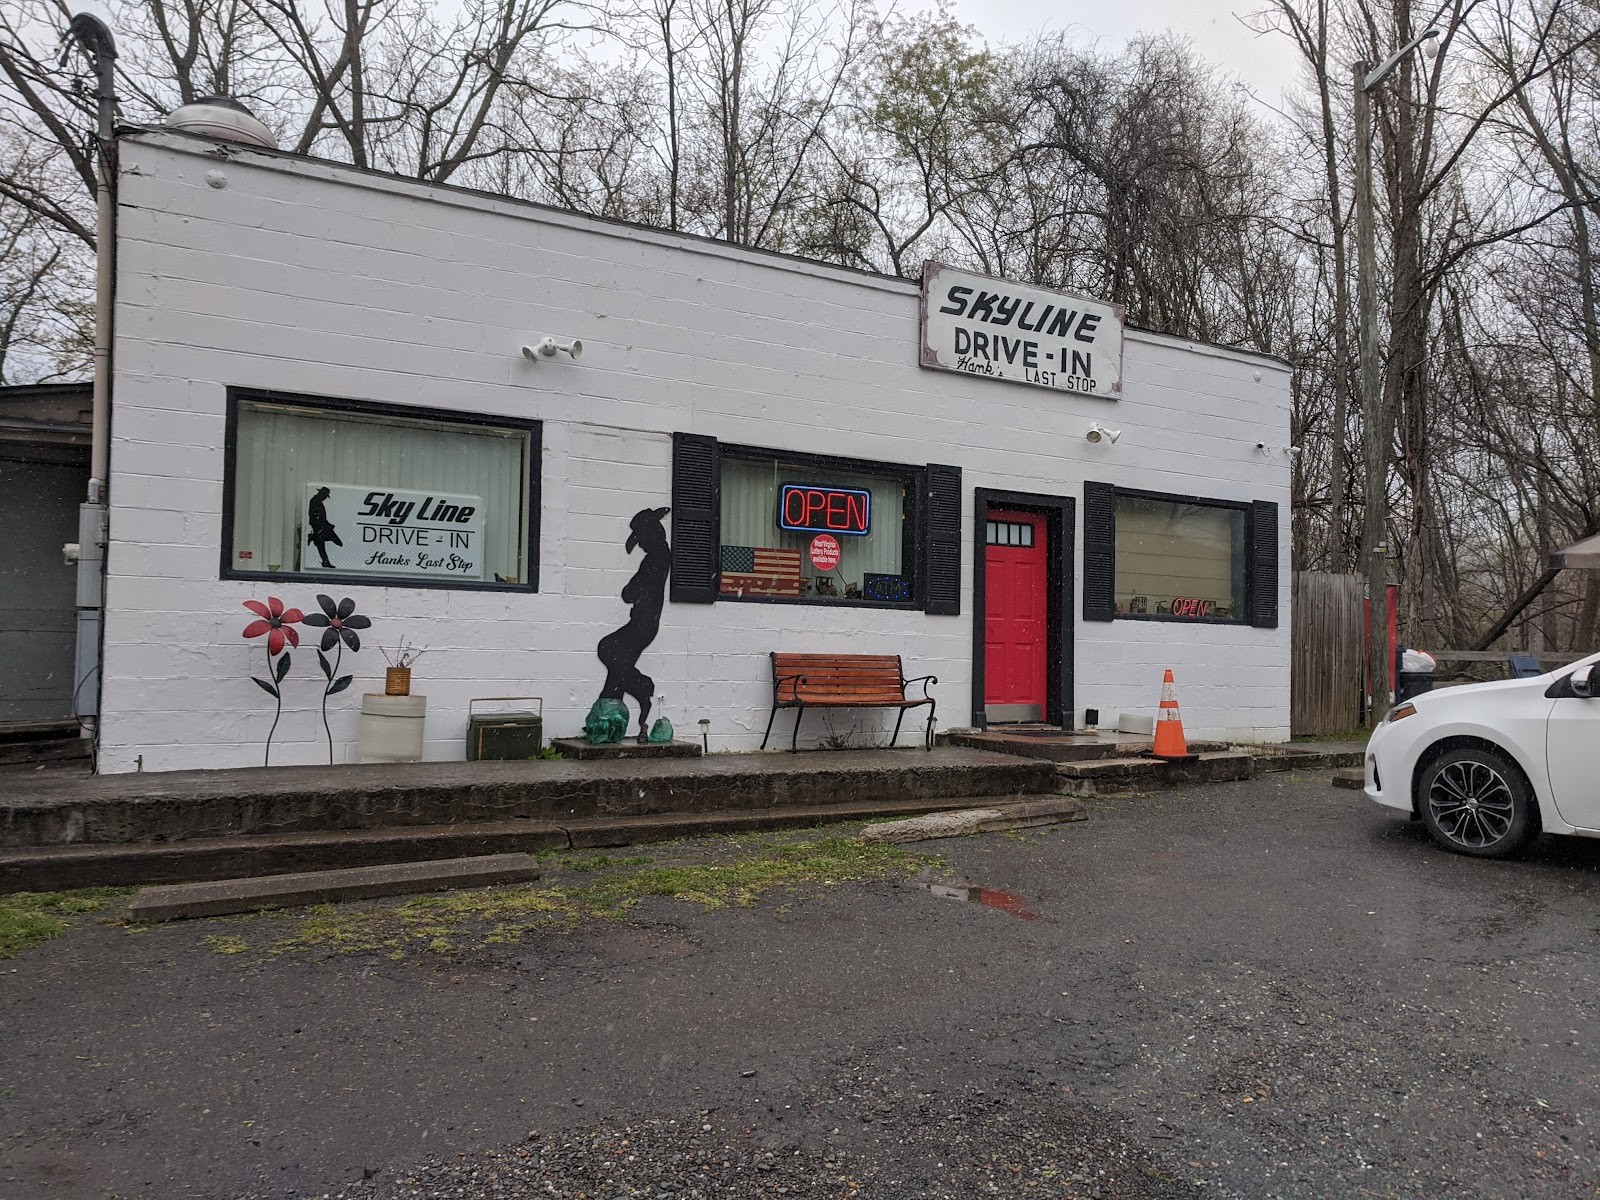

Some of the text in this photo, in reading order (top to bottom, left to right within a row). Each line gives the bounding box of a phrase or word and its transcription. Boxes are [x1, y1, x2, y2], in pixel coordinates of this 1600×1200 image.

[939, 285, 1102, 344] SKYLINE
[1025, 367, 1057, 387] LAST
[1067, 374, 1097, 393] STOP
[357, 491, 475, 524] Sky Line
[785, 489, 866, 530] OPEN
[362, 526, 429, 547] DRIVE
[450, 532, 469, 549] IN
[365, 550, 474, 573] Hanks Last Stop
[1173, 597, 1208, 617] OPEN
